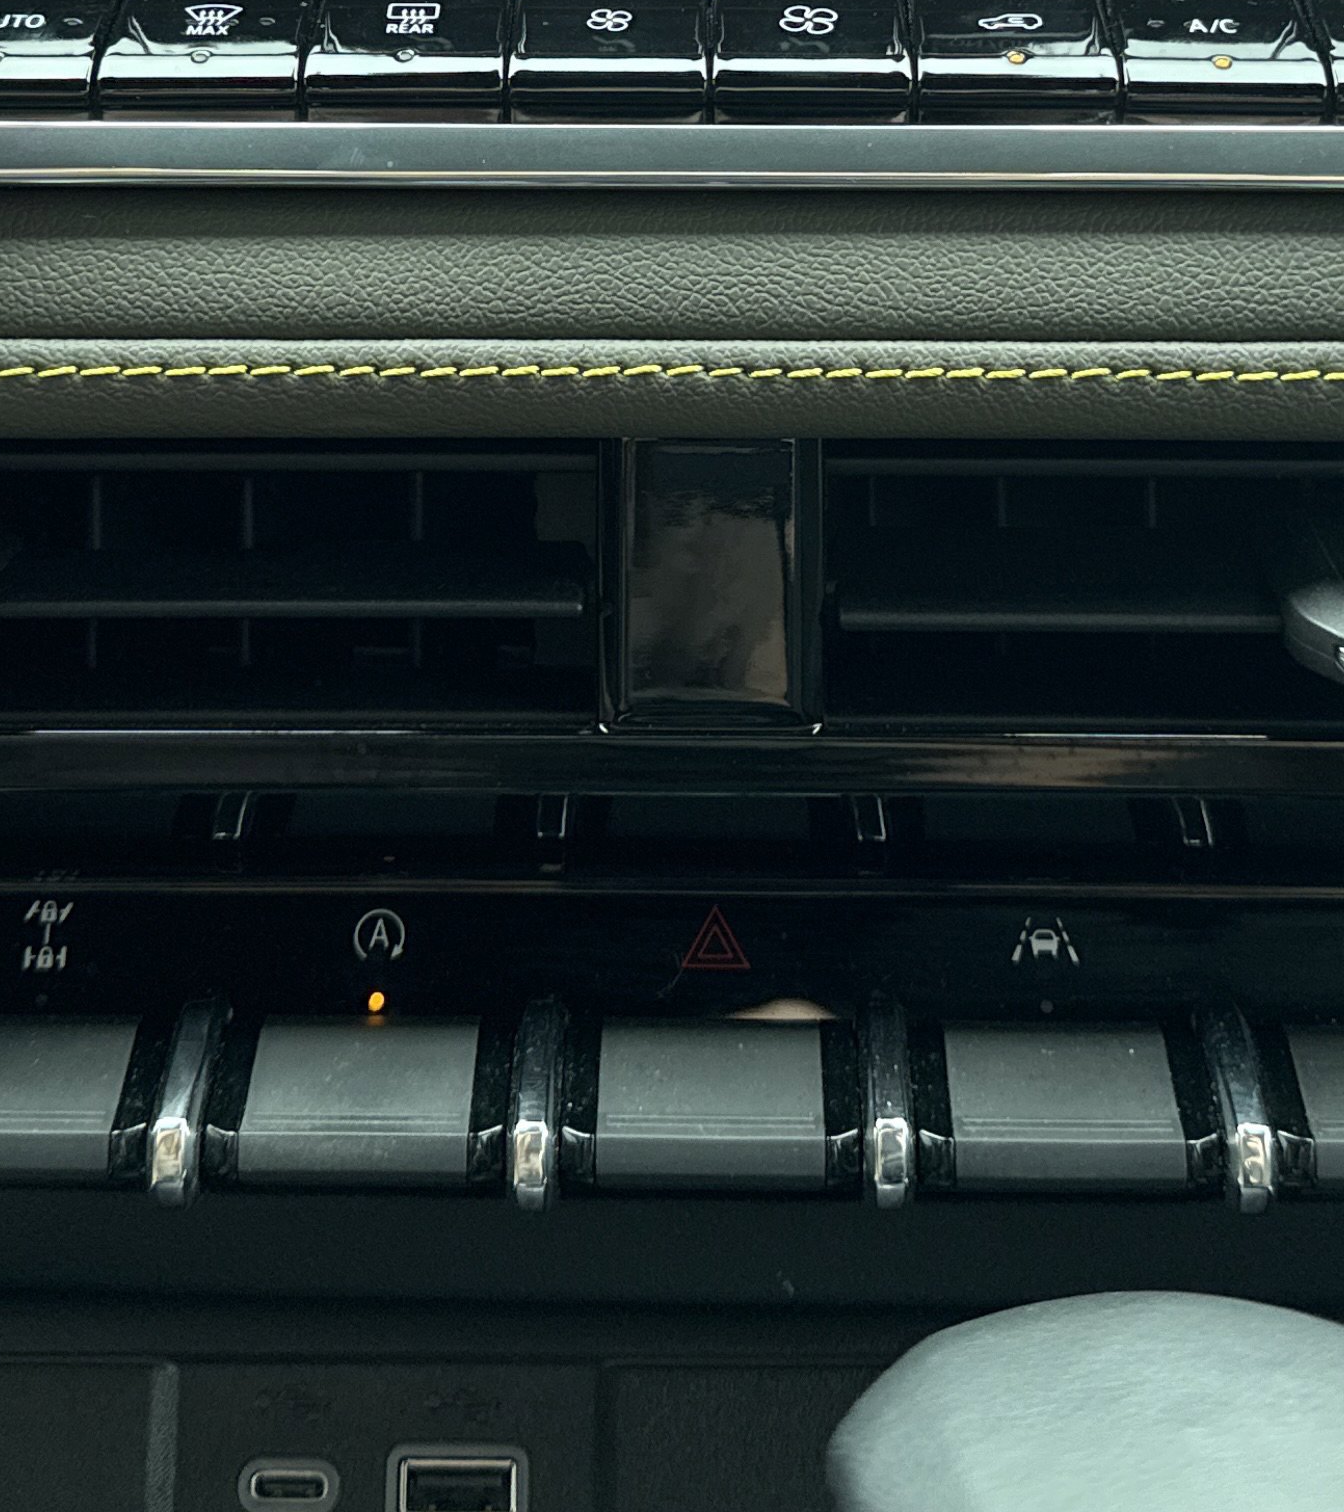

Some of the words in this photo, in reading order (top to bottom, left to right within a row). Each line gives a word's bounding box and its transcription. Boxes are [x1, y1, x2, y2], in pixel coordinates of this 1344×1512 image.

[186, 22, 229, 36] MAX
[385, 23, 434, 34] REAR
[1189, 19, 1238, 34] A/C
